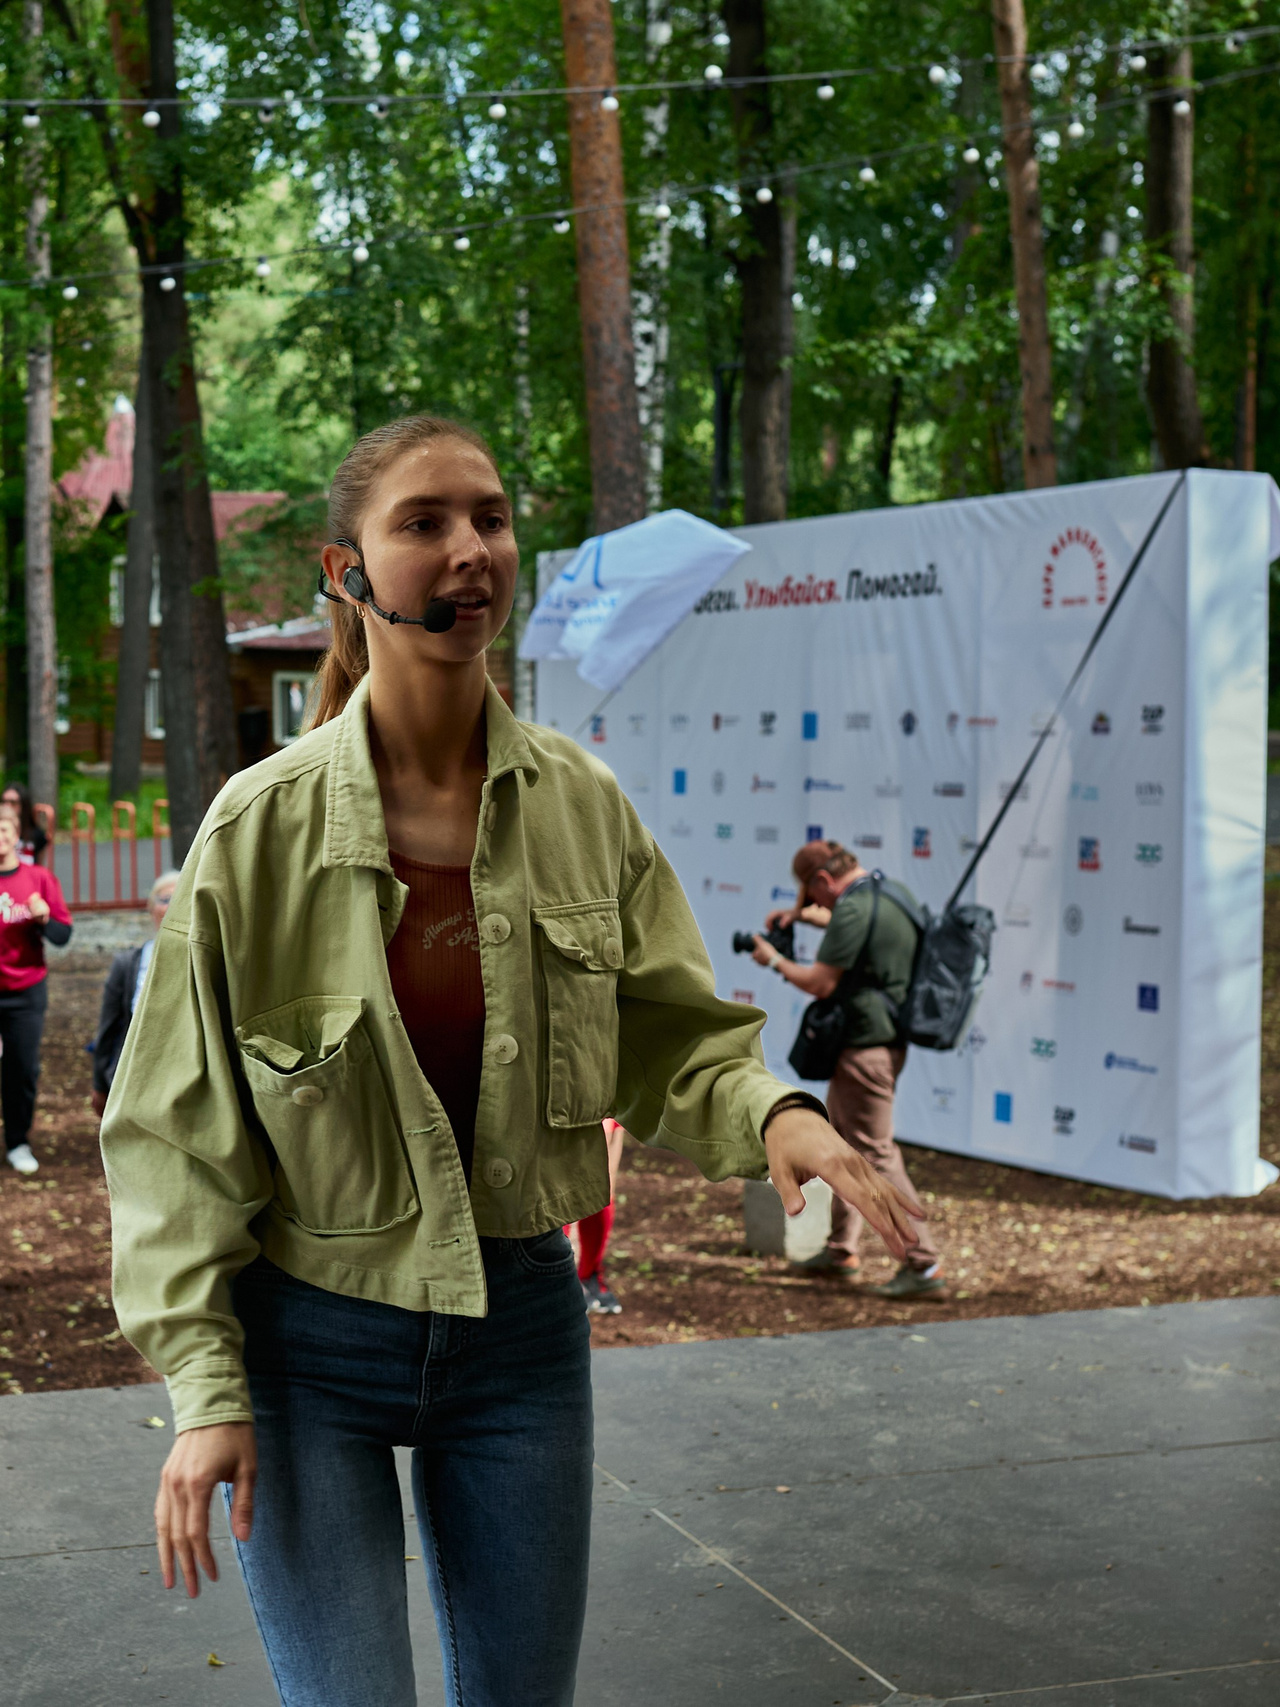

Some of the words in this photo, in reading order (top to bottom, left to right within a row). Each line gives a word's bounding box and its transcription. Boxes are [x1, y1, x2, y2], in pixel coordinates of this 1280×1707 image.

[744, 573, 842, 609] Улыбайся.
[845, 562, 943, 601] Помогай.
[422, 912, 462, 950] Always
